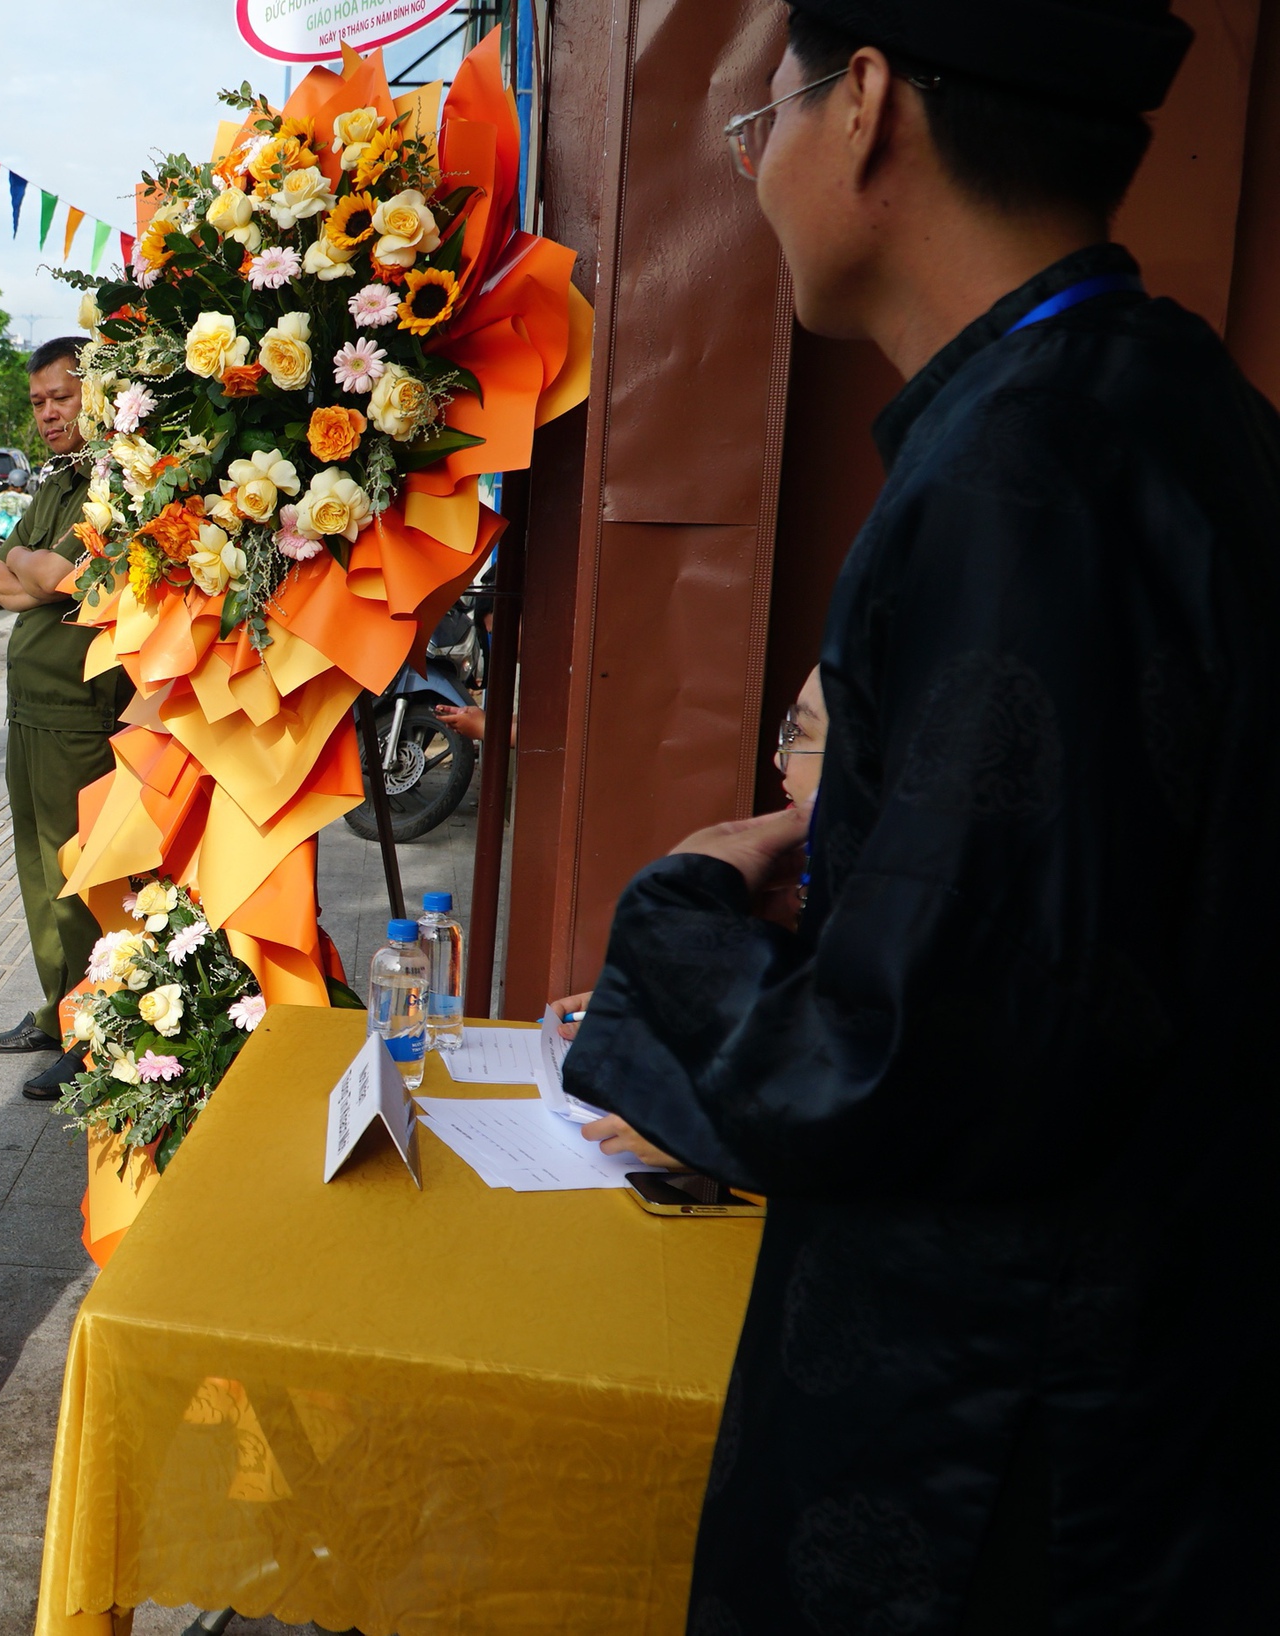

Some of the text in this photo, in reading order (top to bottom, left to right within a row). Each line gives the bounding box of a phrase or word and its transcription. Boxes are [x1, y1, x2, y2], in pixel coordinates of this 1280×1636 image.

[307, 7, 331, 31] GIÁO
[319, 30, 336, 46] NGÀY
[338, 28, 347, 41] 18
[347, 19, 369, 36] THÁNG
[370, 18, 375, 28] 5
[393, 5, 410, 20] BÍNH
